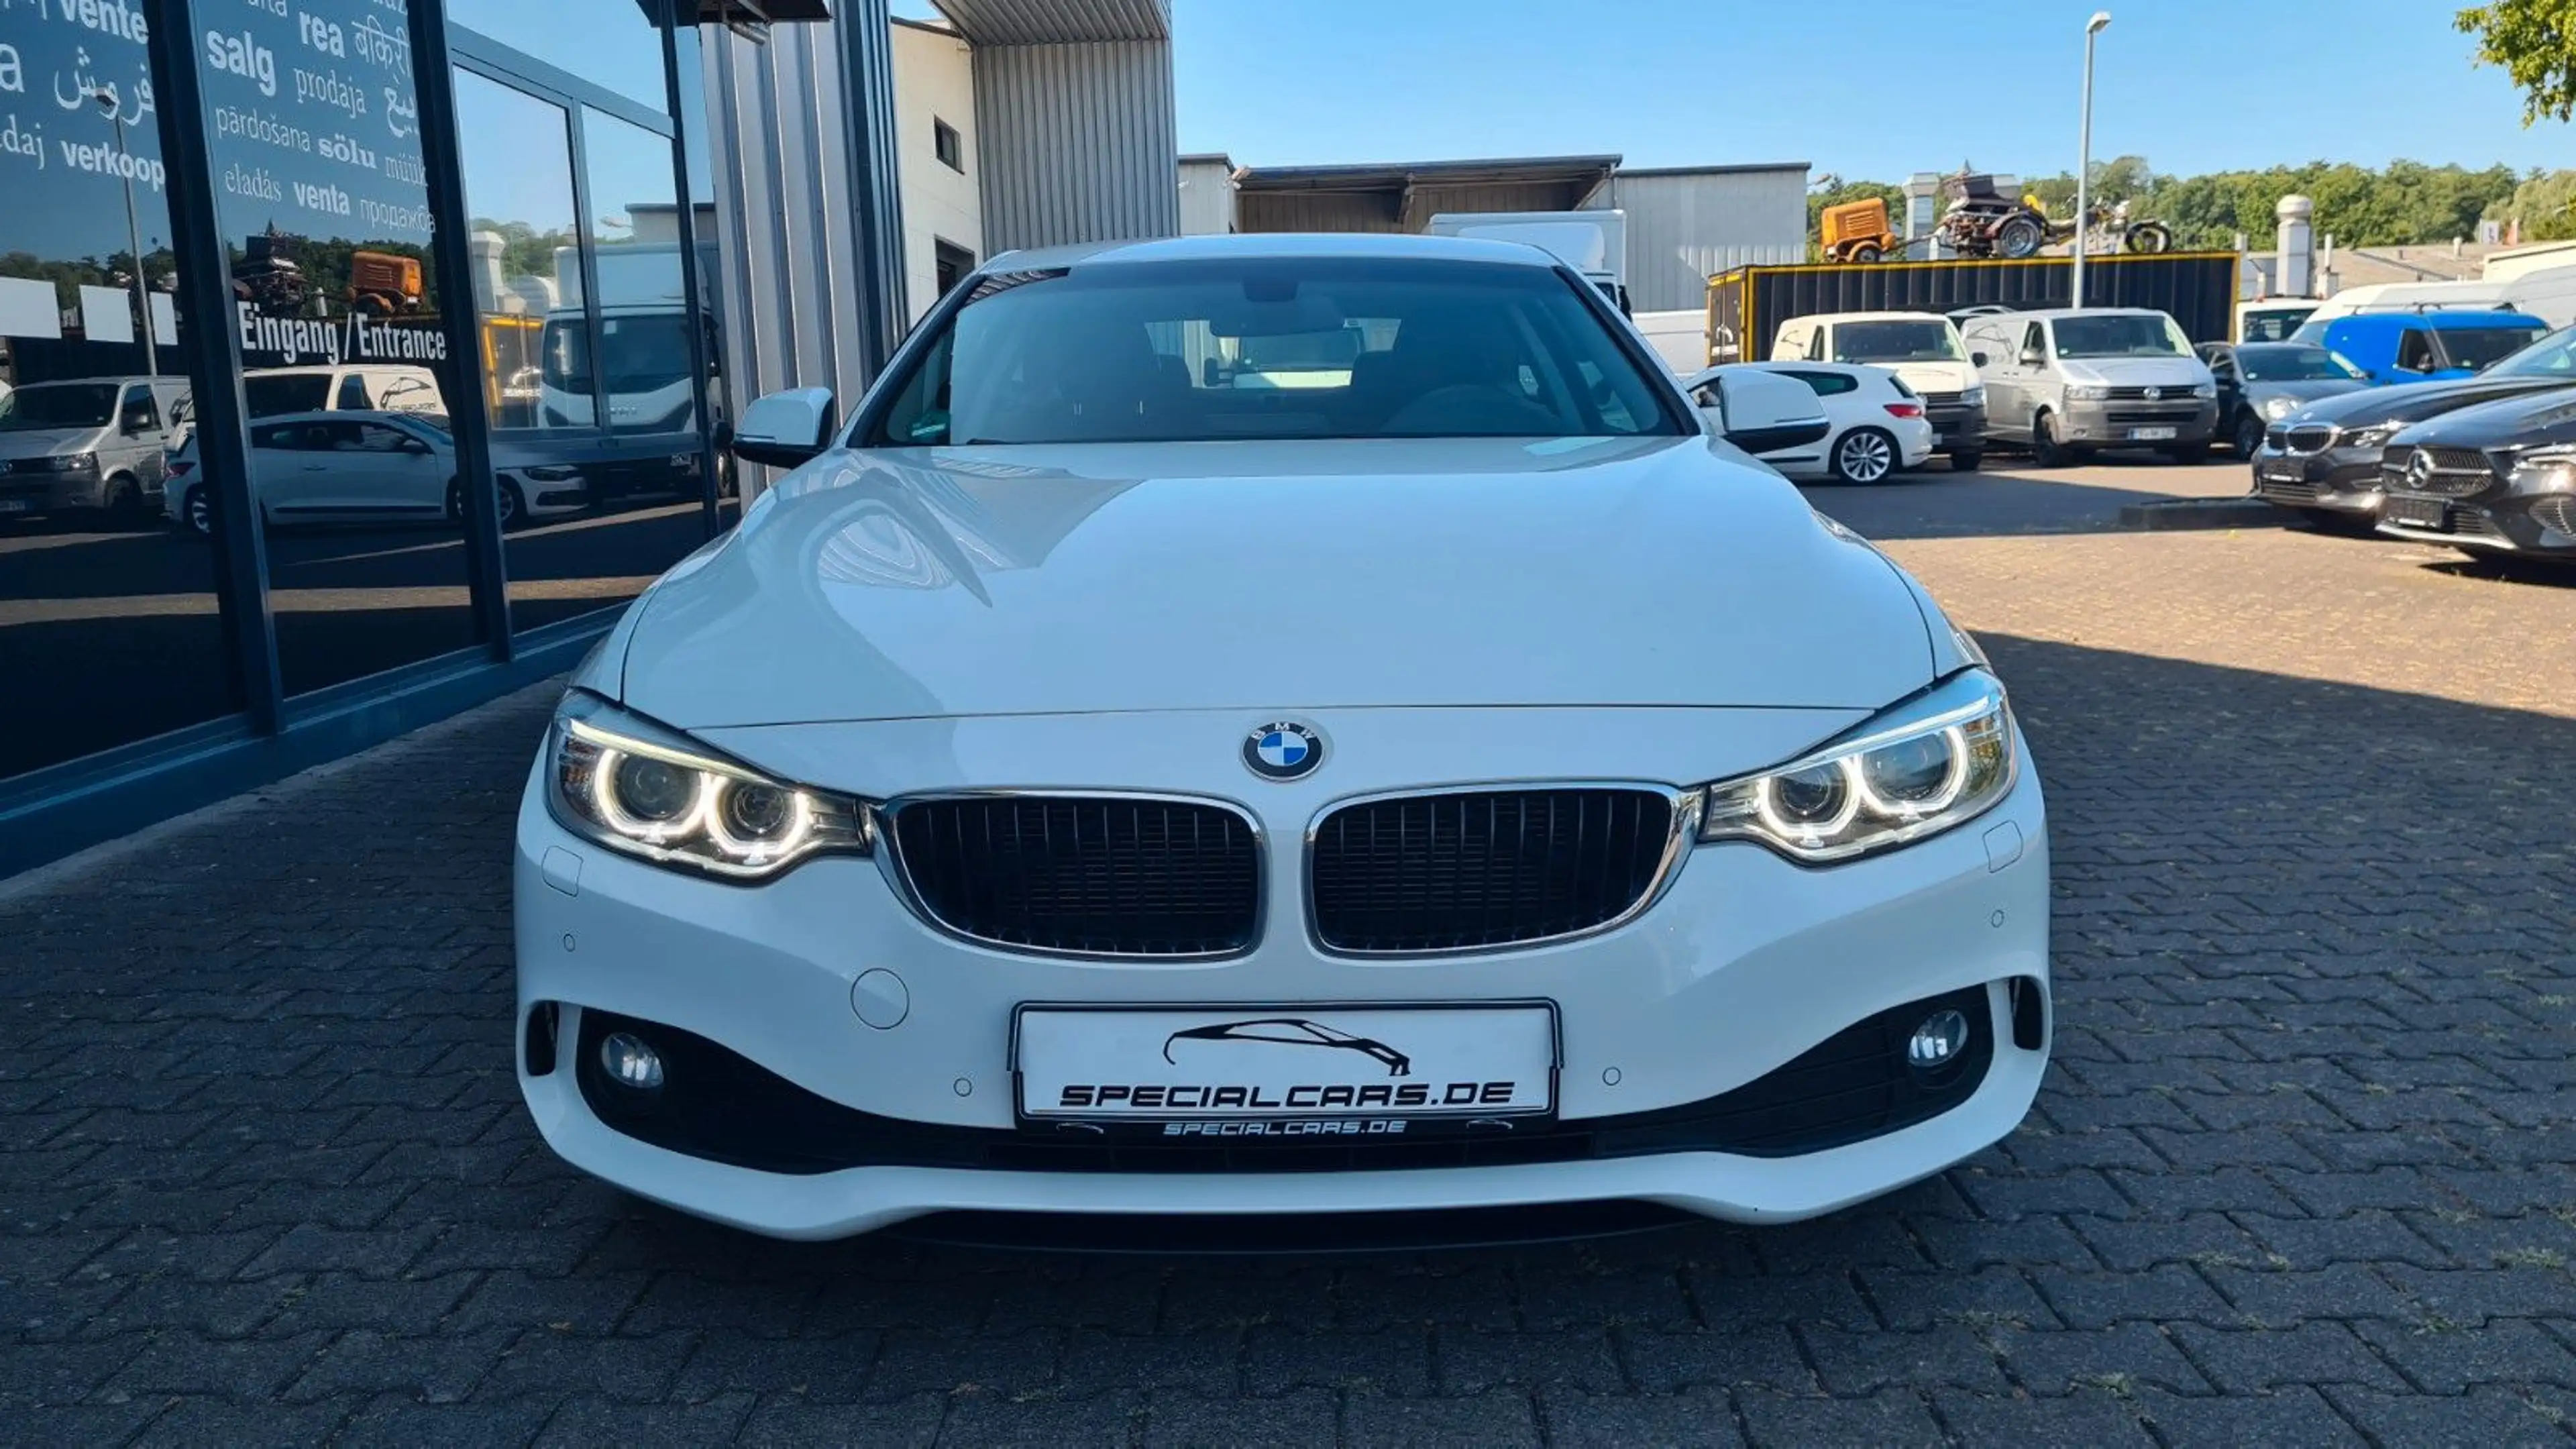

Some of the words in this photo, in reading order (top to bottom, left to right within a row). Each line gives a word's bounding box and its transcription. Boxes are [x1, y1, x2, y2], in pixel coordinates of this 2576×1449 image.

[60, 0, 149, 44] vente
[299, 11, 346, 58] rea
[207, 30, 276, 97] salg
[293, 68, 367, 119] prodaja
[215, 106, 311, 152] pārdošana
[319, 133, 377, 169] sölu
[60, 140, 166, 193] verkoop
[225, 162, 282, 202] eladás
[293, 181, 350, 216] venta
[237, 301, 338, 365] Eingang
[356, 313, 447, 360] Entrance
[1060, 1082, 1515, 1107] SPECIALCARS.DE
[1163, 1120, 1407, 1135] SPECIALCARS.DE
